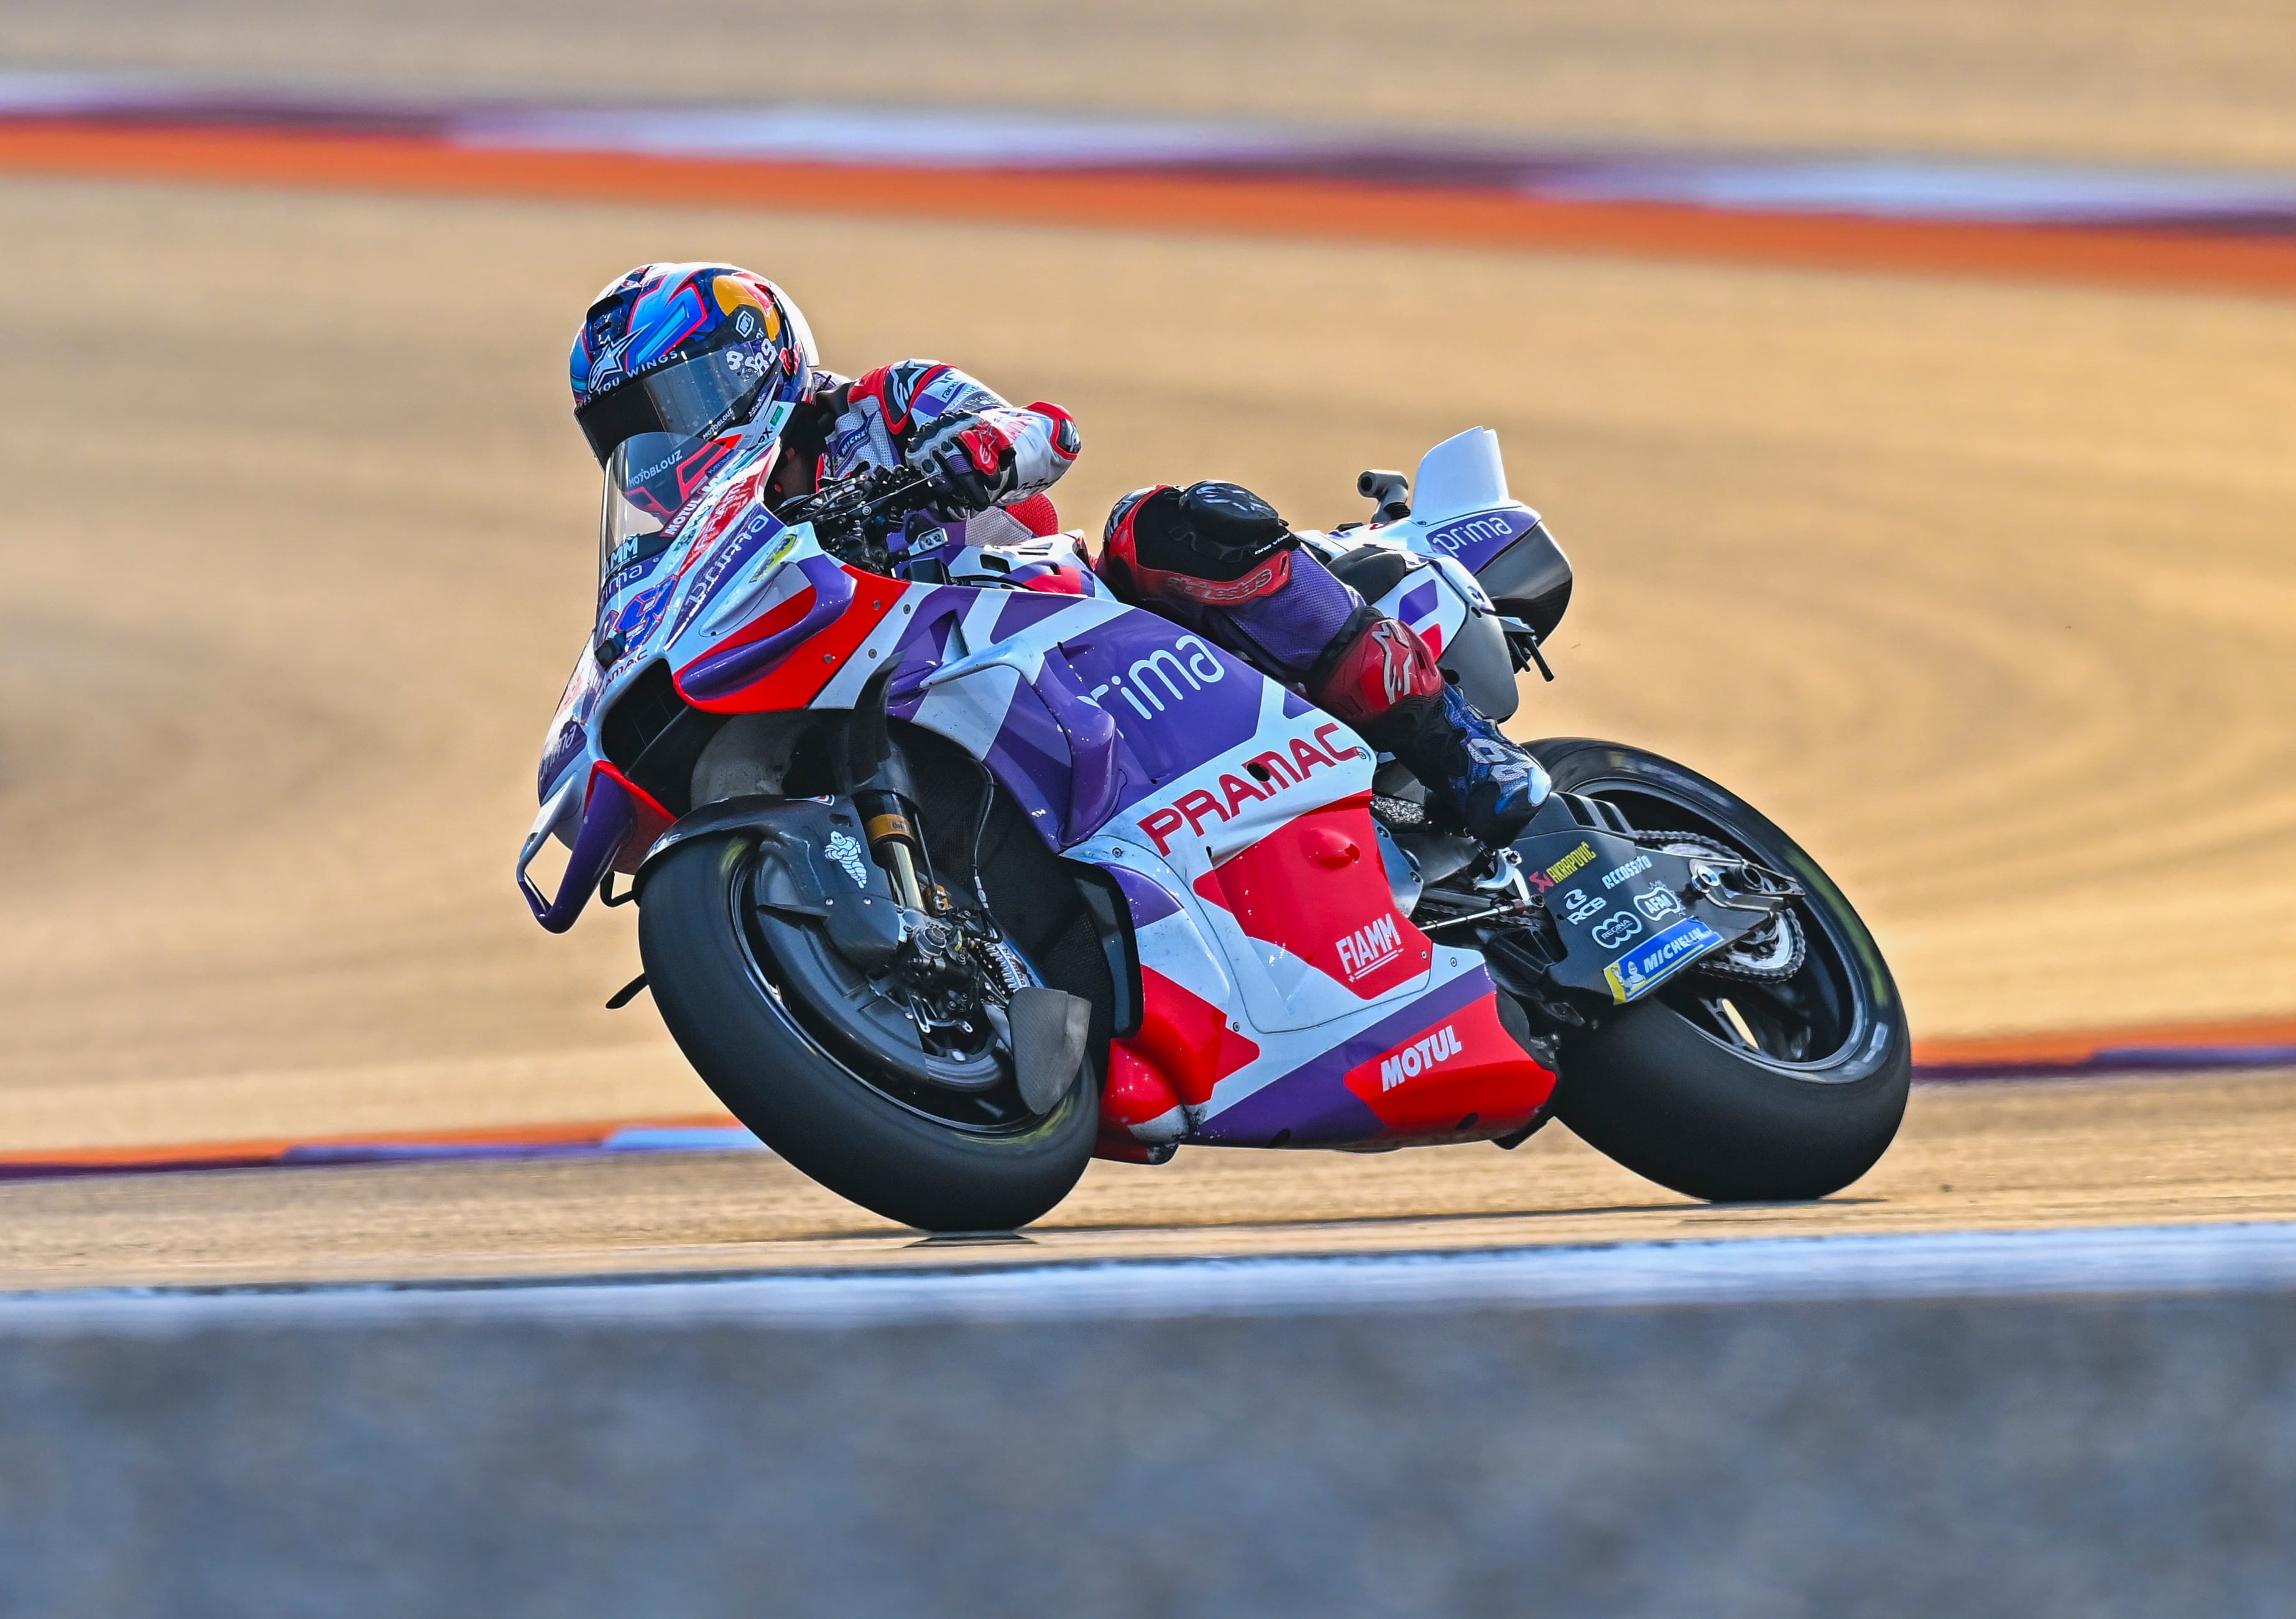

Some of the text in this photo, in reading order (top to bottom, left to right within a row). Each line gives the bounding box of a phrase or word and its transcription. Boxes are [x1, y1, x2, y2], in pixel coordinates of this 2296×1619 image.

[596, 377, 620, 396] YOU
[627, 350, 678, 379] WINGS
[702, 407, 734, 440] MOTOBLOUZ
[629, 449, 683, 487] MOTOBLOUZ
[664, 497, 703, 535] MOTUL
[1432, 517, 1512, 558] prima
[1136, 722, 1360, 857] PRAMAC
[1566, 897, 1607, 925] RCB
[1644, 893, 1673, 914] AFAM
[1335, 913, 1402, 975] FIAMM
[1601, 919, 1633, 939] REGINA
[1643, 927, 1705, 974] MICHELIN
[1380, 1024, 1462, 1093] MOTUL
